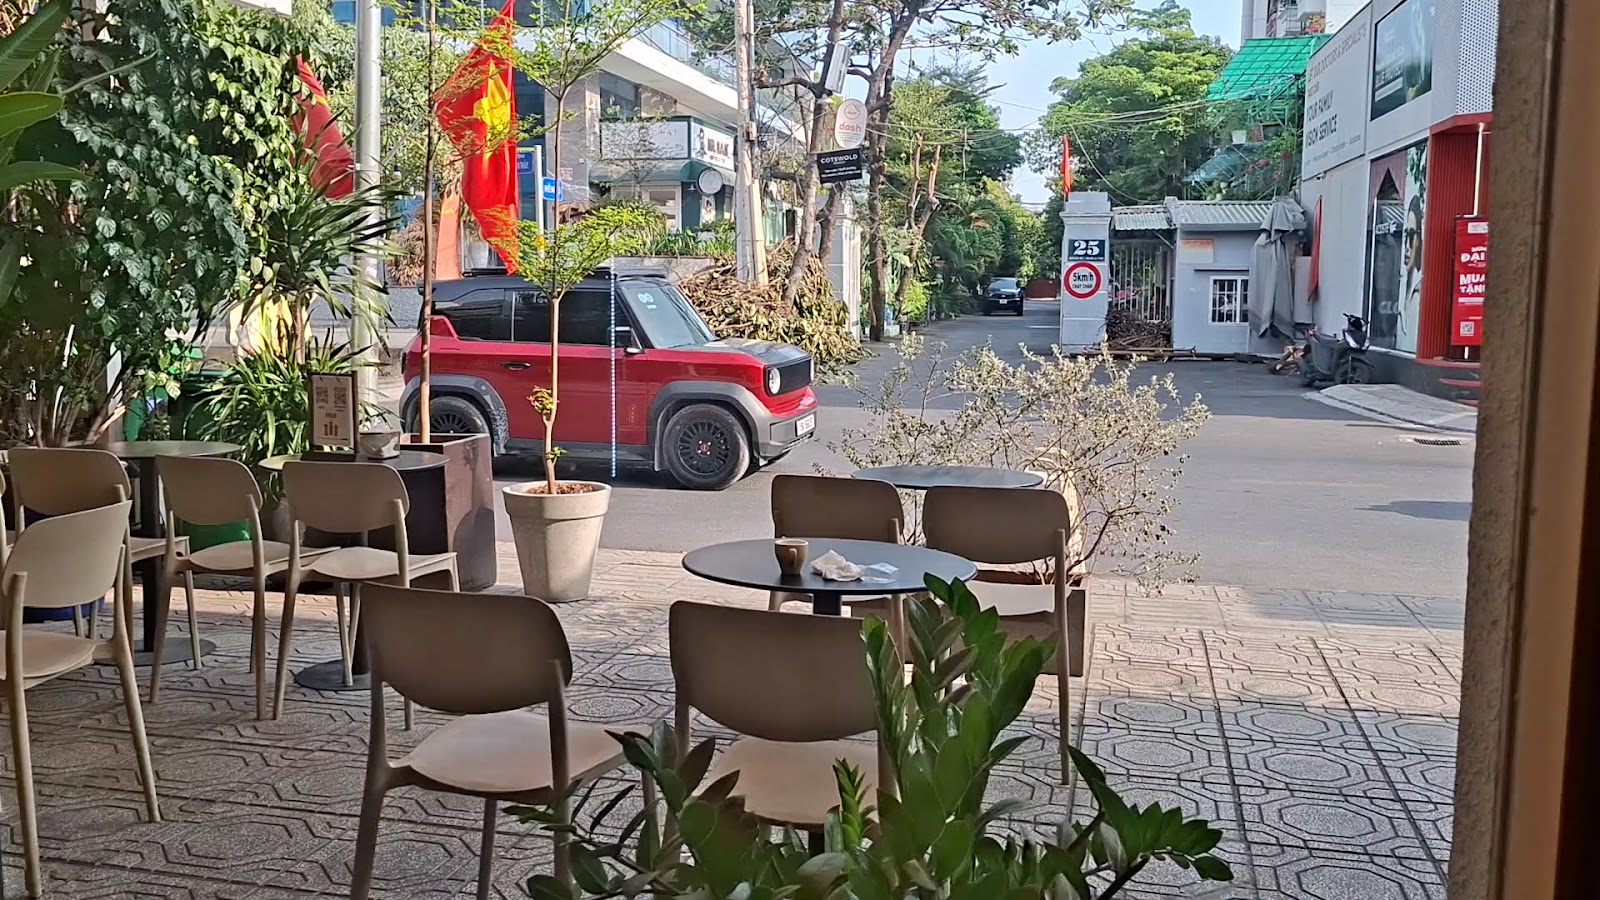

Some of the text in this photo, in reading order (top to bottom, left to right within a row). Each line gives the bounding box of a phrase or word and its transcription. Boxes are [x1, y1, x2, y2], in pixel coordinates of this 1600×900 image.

[839, 121, 862, 132] dosh
[820, 153, 858, 164] COTSWOLD
[1073, 240, 1100, 256] 25
[1073, 271, 1094, 282] 5km/h
[1459, 283, 1485, 295] TẶN
